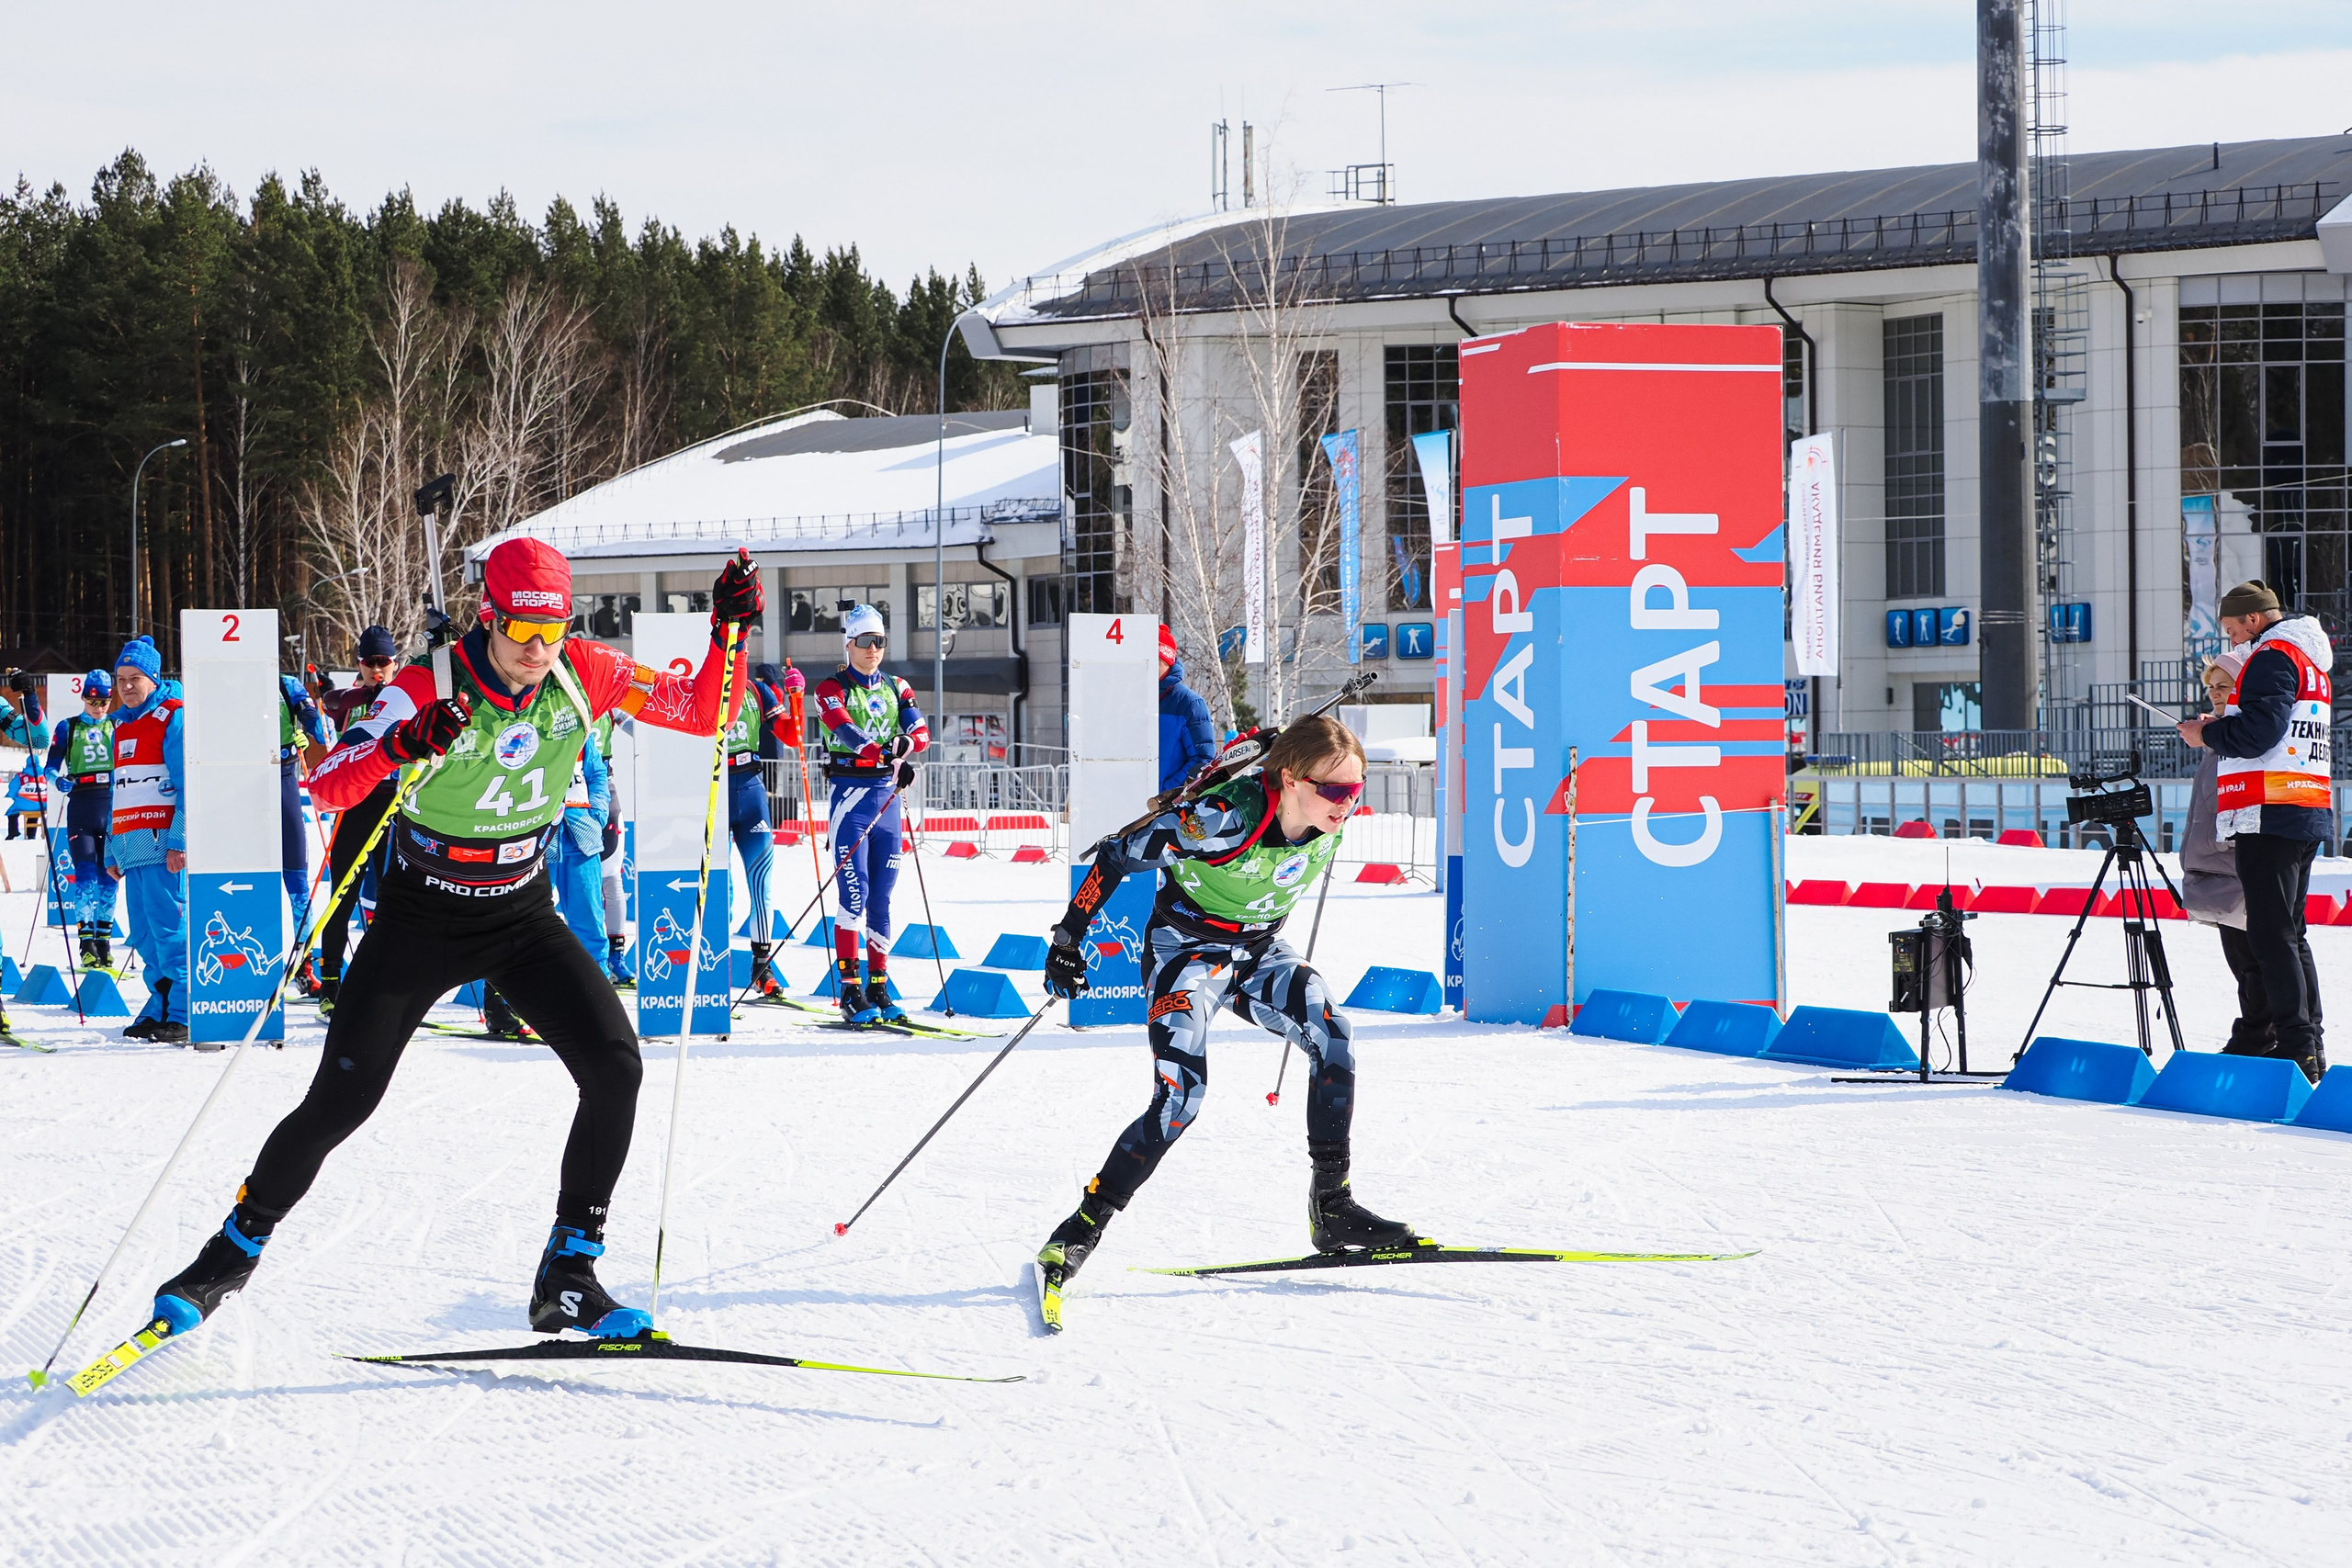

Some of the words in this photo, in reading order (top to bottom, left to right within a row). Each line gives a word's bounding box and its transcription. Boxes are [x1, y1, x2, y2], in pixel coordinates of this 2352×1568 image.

[512, 599, 564, 610] СПОРТ
[222, 615, 240, 641] 2
[1106, 619, 1124, 644] 4
[72, 678, 82, 694] 3
[1492, 493, 1535, 868] СТАРТ
[1629, 487, 1723, 867] СТАРТ
[447, 701, 467, 722] LEKI
[864, 718, 891, 740] 44
[84, 745, 109, 763] 59
[1225, 744, 1251, 761] LARSEN
[474, 767, 550, 817] 41
[141, 810, 166, 819] край
[474, 813, 545, 833] КРАСНОЯРСК
[425, 875, 471, 897] PRO
[474, 855, 546, 897] COMBAT
[1074, 864, 1103, 908] ZERO
[640, 993, 728, 1010] КРАСНЯРСК
[1077, 986, 1147, 999] РАСНОЯРС
[1148, 996, 1192, 1018] ZERO
[1371, 1252, 1413, 1260] FISCHER
[598, 1343, 642, 1351] FISCHER
